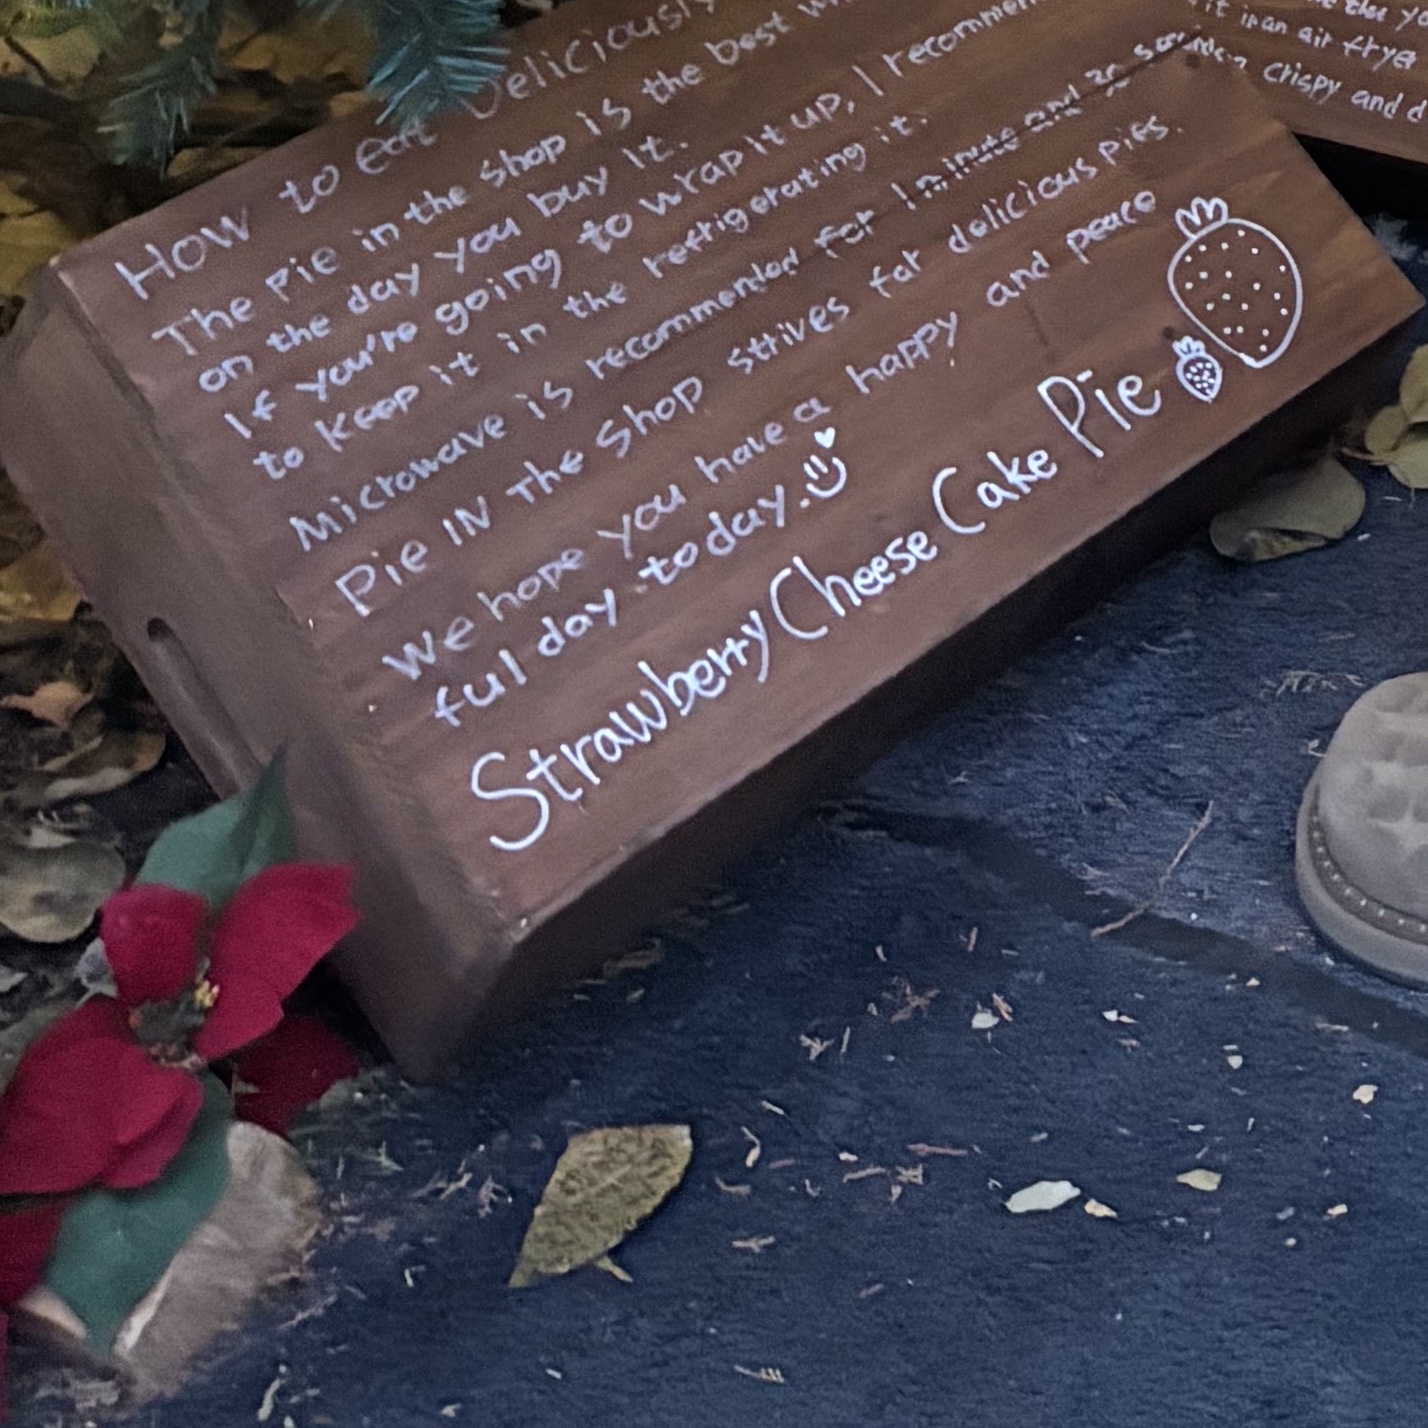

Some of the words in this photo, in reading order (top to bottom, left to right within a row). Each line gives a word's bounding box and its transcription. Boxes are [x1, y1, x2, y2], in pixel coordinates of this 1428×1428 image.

[152, 296, 253, 356] The
[353, 221, 399, 252] in
[404, 186, 467, 226] the
[576, 99, 631, 135] is
[643, 62, 703, 107] the
[705, 12, 790, 66] best
[279, 164, 338, 214] to
[1350, 91, 1403, 121] and
[198, 354, 252, 392] on
[267, 314, 330, 353] the
[346, 264, 420, 315] day
[435, 217, 521, 272] you
[527, 166, 608, 219] buy
[223, 389, 276, 439] If
[435, 249, 562, 336] going
[579, 214, 632, 252] to
[640, 149, 742, 217] wrap
[727, 295, 850, 375] strives
[869, 250, 922, 299] for
[947, 157, 1097, 256] delicious
[254, 449, 304, 481] to
[430, 352, 479, 385] it
[498, 324, 546, 353] in
[563, 282, 626, 320] the
[289, 413, 507, 551] Microwave
[516, 381, 574, 419] is
[586, 247, 799, 382] recommended
[477, 547, 584, 621] hope
[597, 485, 686, 560] you
[693, 422, 786, 485] have
[794, 397, 832, 423] a
[846, 311, 958, 393] happy
[986, 251, 1050, 307] and
[1067, 190, 1156, 264] peace
[434, 649, 527, 726] ful
[537, 588, 617, 657] day
[470, 609, 770, 851] Strawberry
[769, 530, 937, 639] Cheese
[932, 449, 1058, 534] Cake
[1037, 370, 1162, 458] Pie
